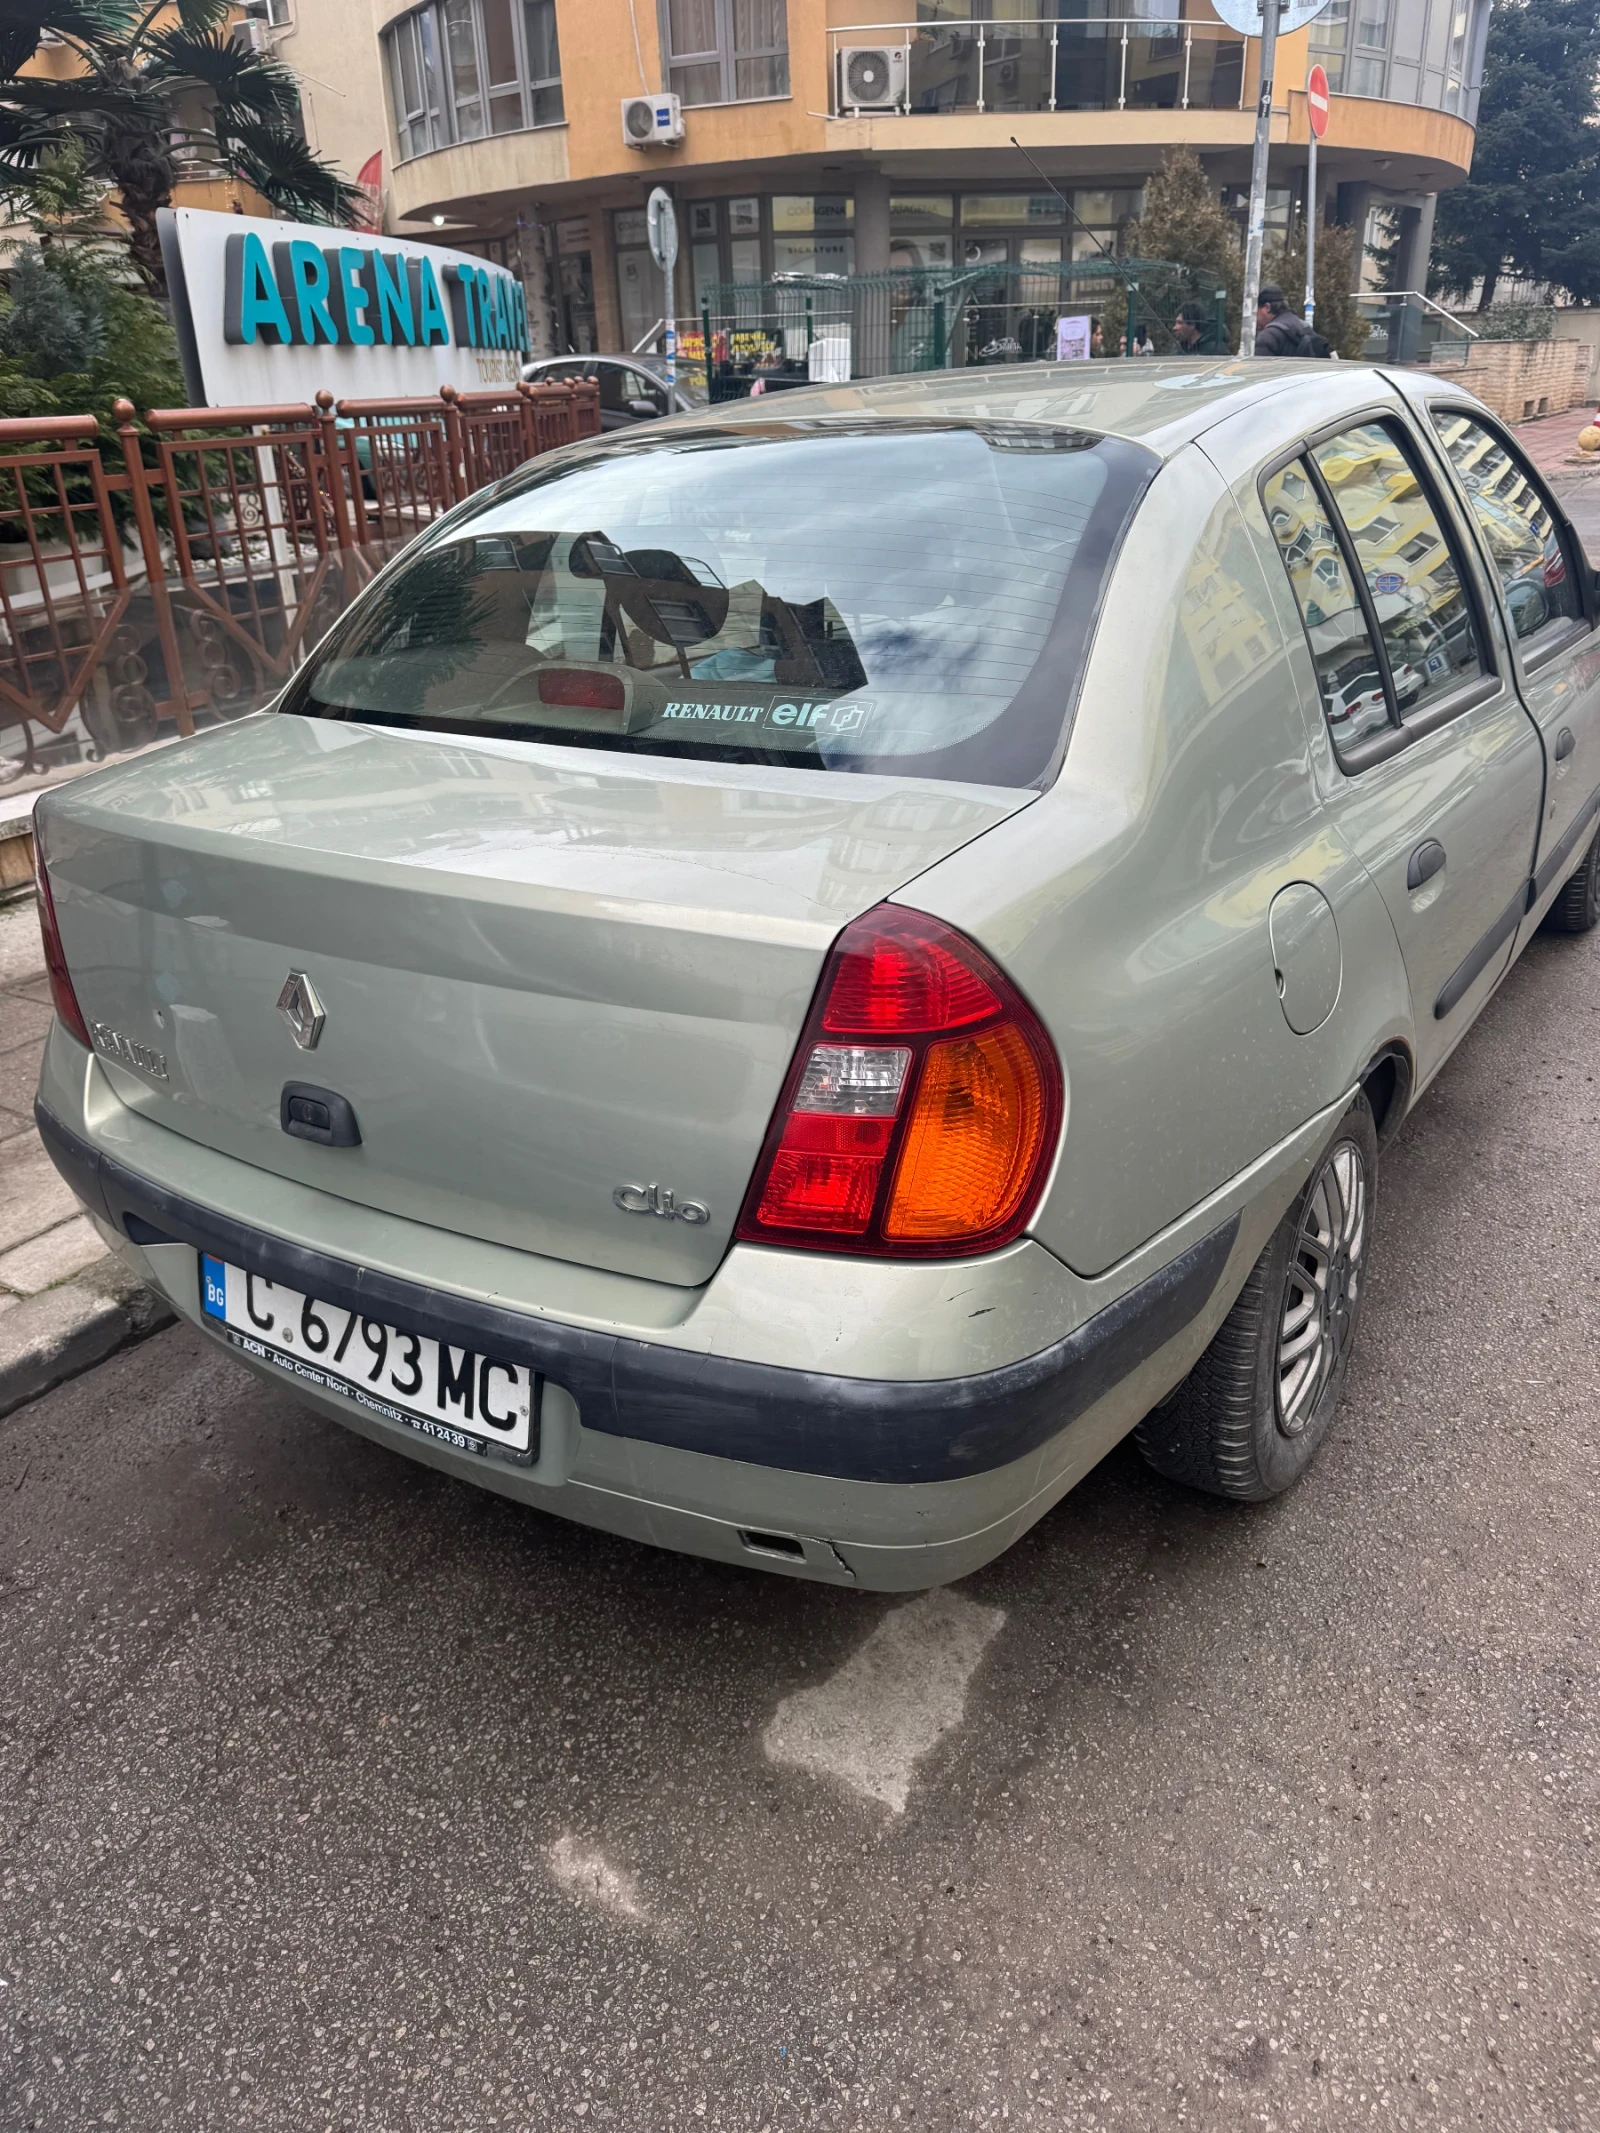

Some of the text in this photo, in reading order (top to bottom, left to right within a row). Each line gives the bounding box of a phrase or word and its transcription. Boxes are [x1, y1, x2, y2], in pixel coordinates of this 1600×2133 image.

[787, 246, 844, 254] SIGNATURE
[239, 232, 532, 352] ARENA TRAVEL
[661, 702, 831, 728] RENAULT elf
[612, 1182, 711, 1225] Clio
[208, 1283, 224, 1307] BG
[243, 1340, 265, 1358] ACN
[273, 1353, 293, 1371] Auto
[295, 1363, 324, 1385] Center
[326, 1377, 348, 1396] Nord
[356, 1391, 403, 1423] Chemnitz
[437, 1342, 518, 1431] MC
